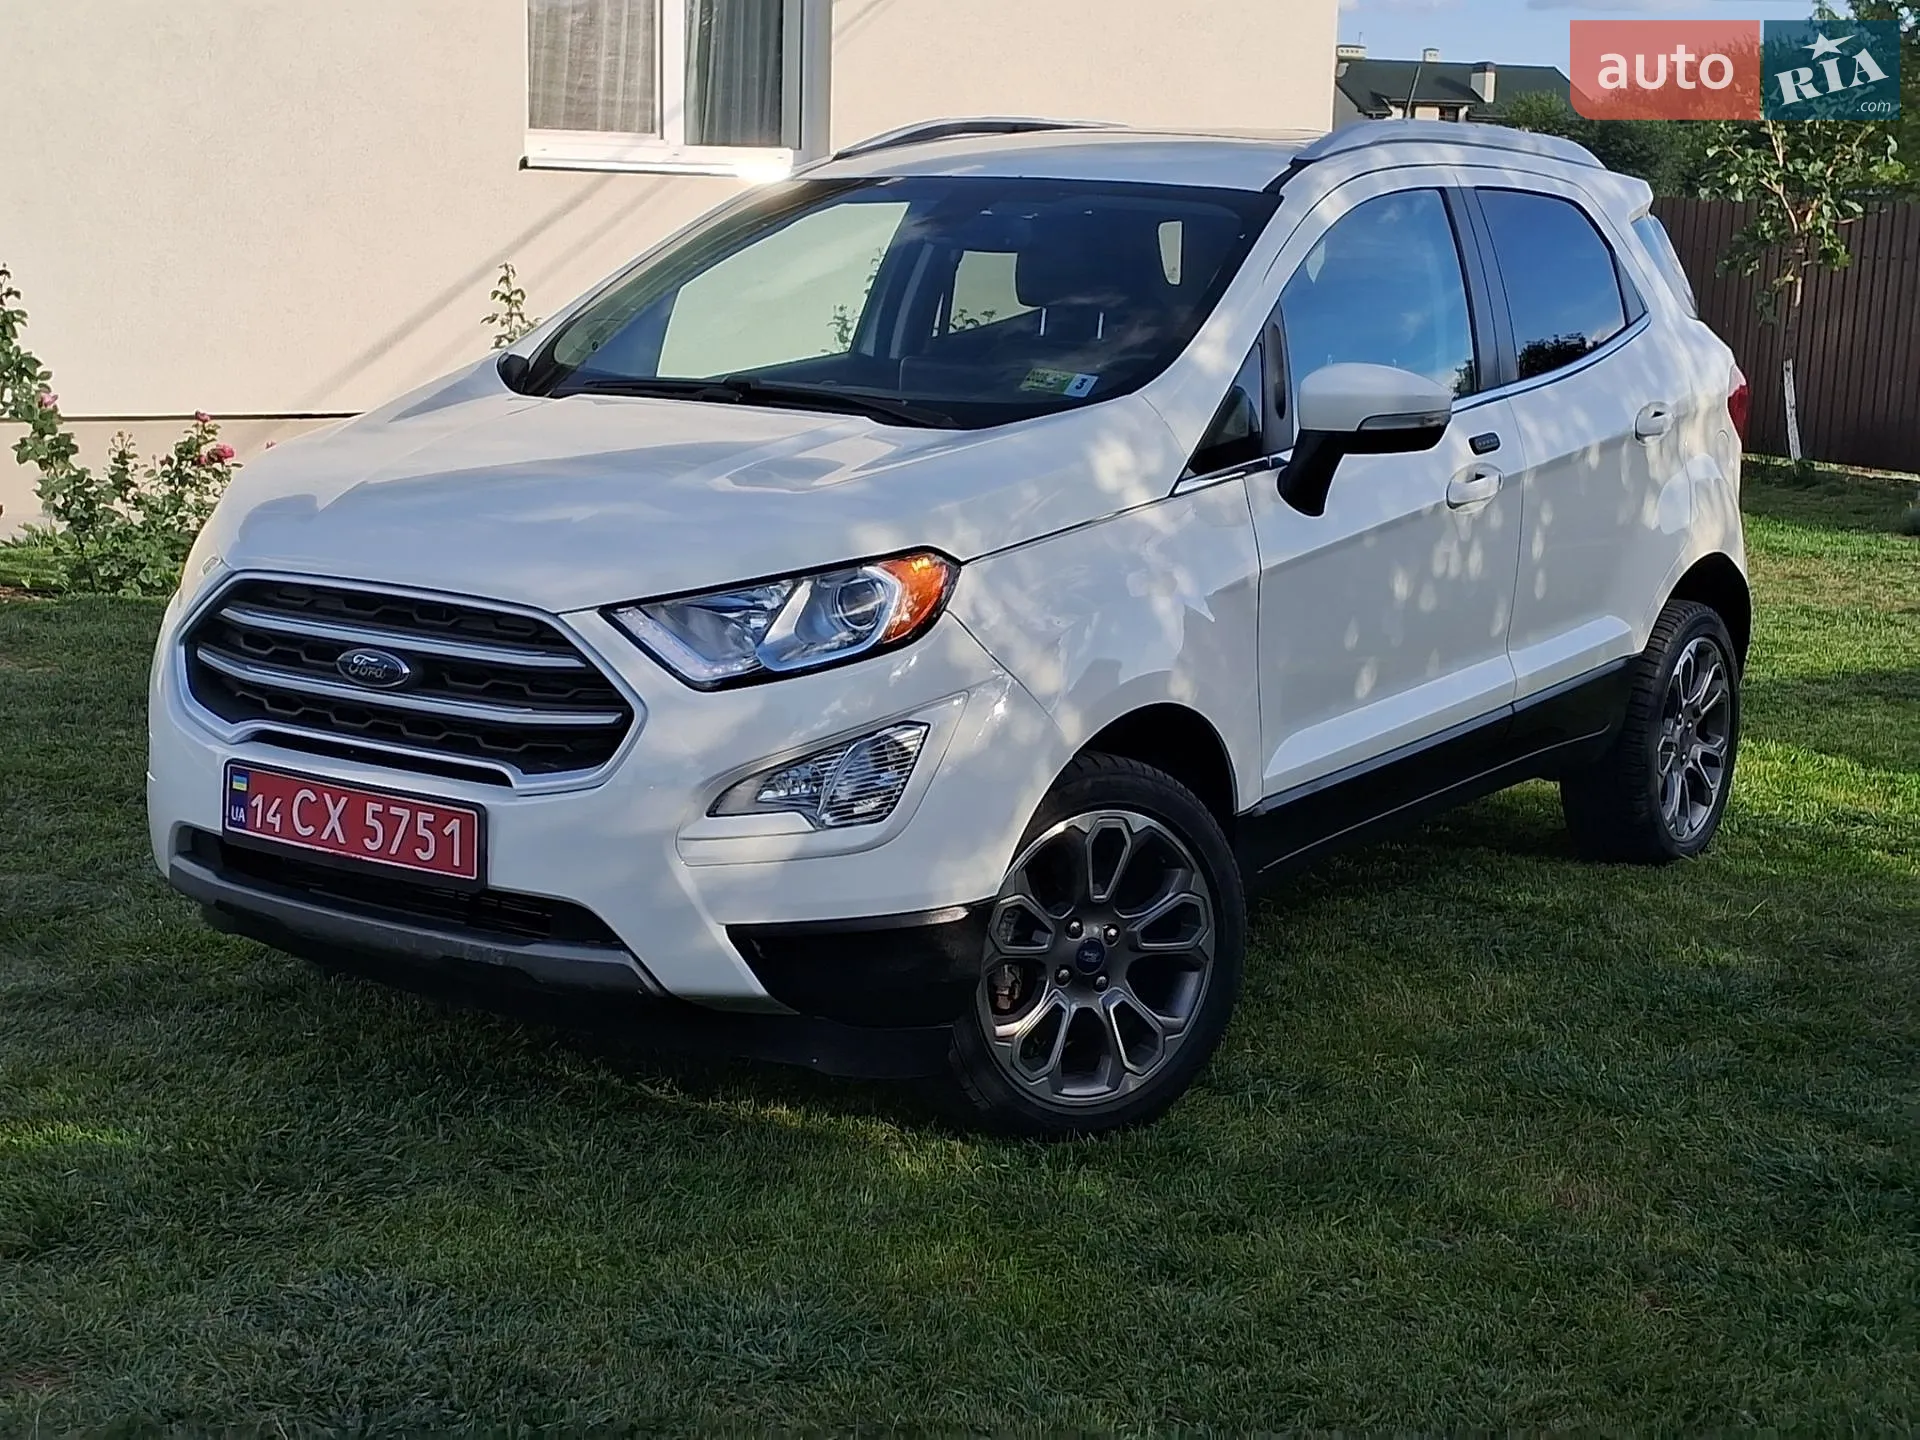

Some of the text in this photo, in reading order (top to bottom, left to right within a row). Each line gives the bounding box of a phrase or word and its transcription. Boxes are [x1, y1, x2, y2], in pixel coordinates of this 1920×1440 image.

[348, 654, 388, 679] Ford
[230, 805, 246, 823] UA
[362, 801, 461, 867] 5751
